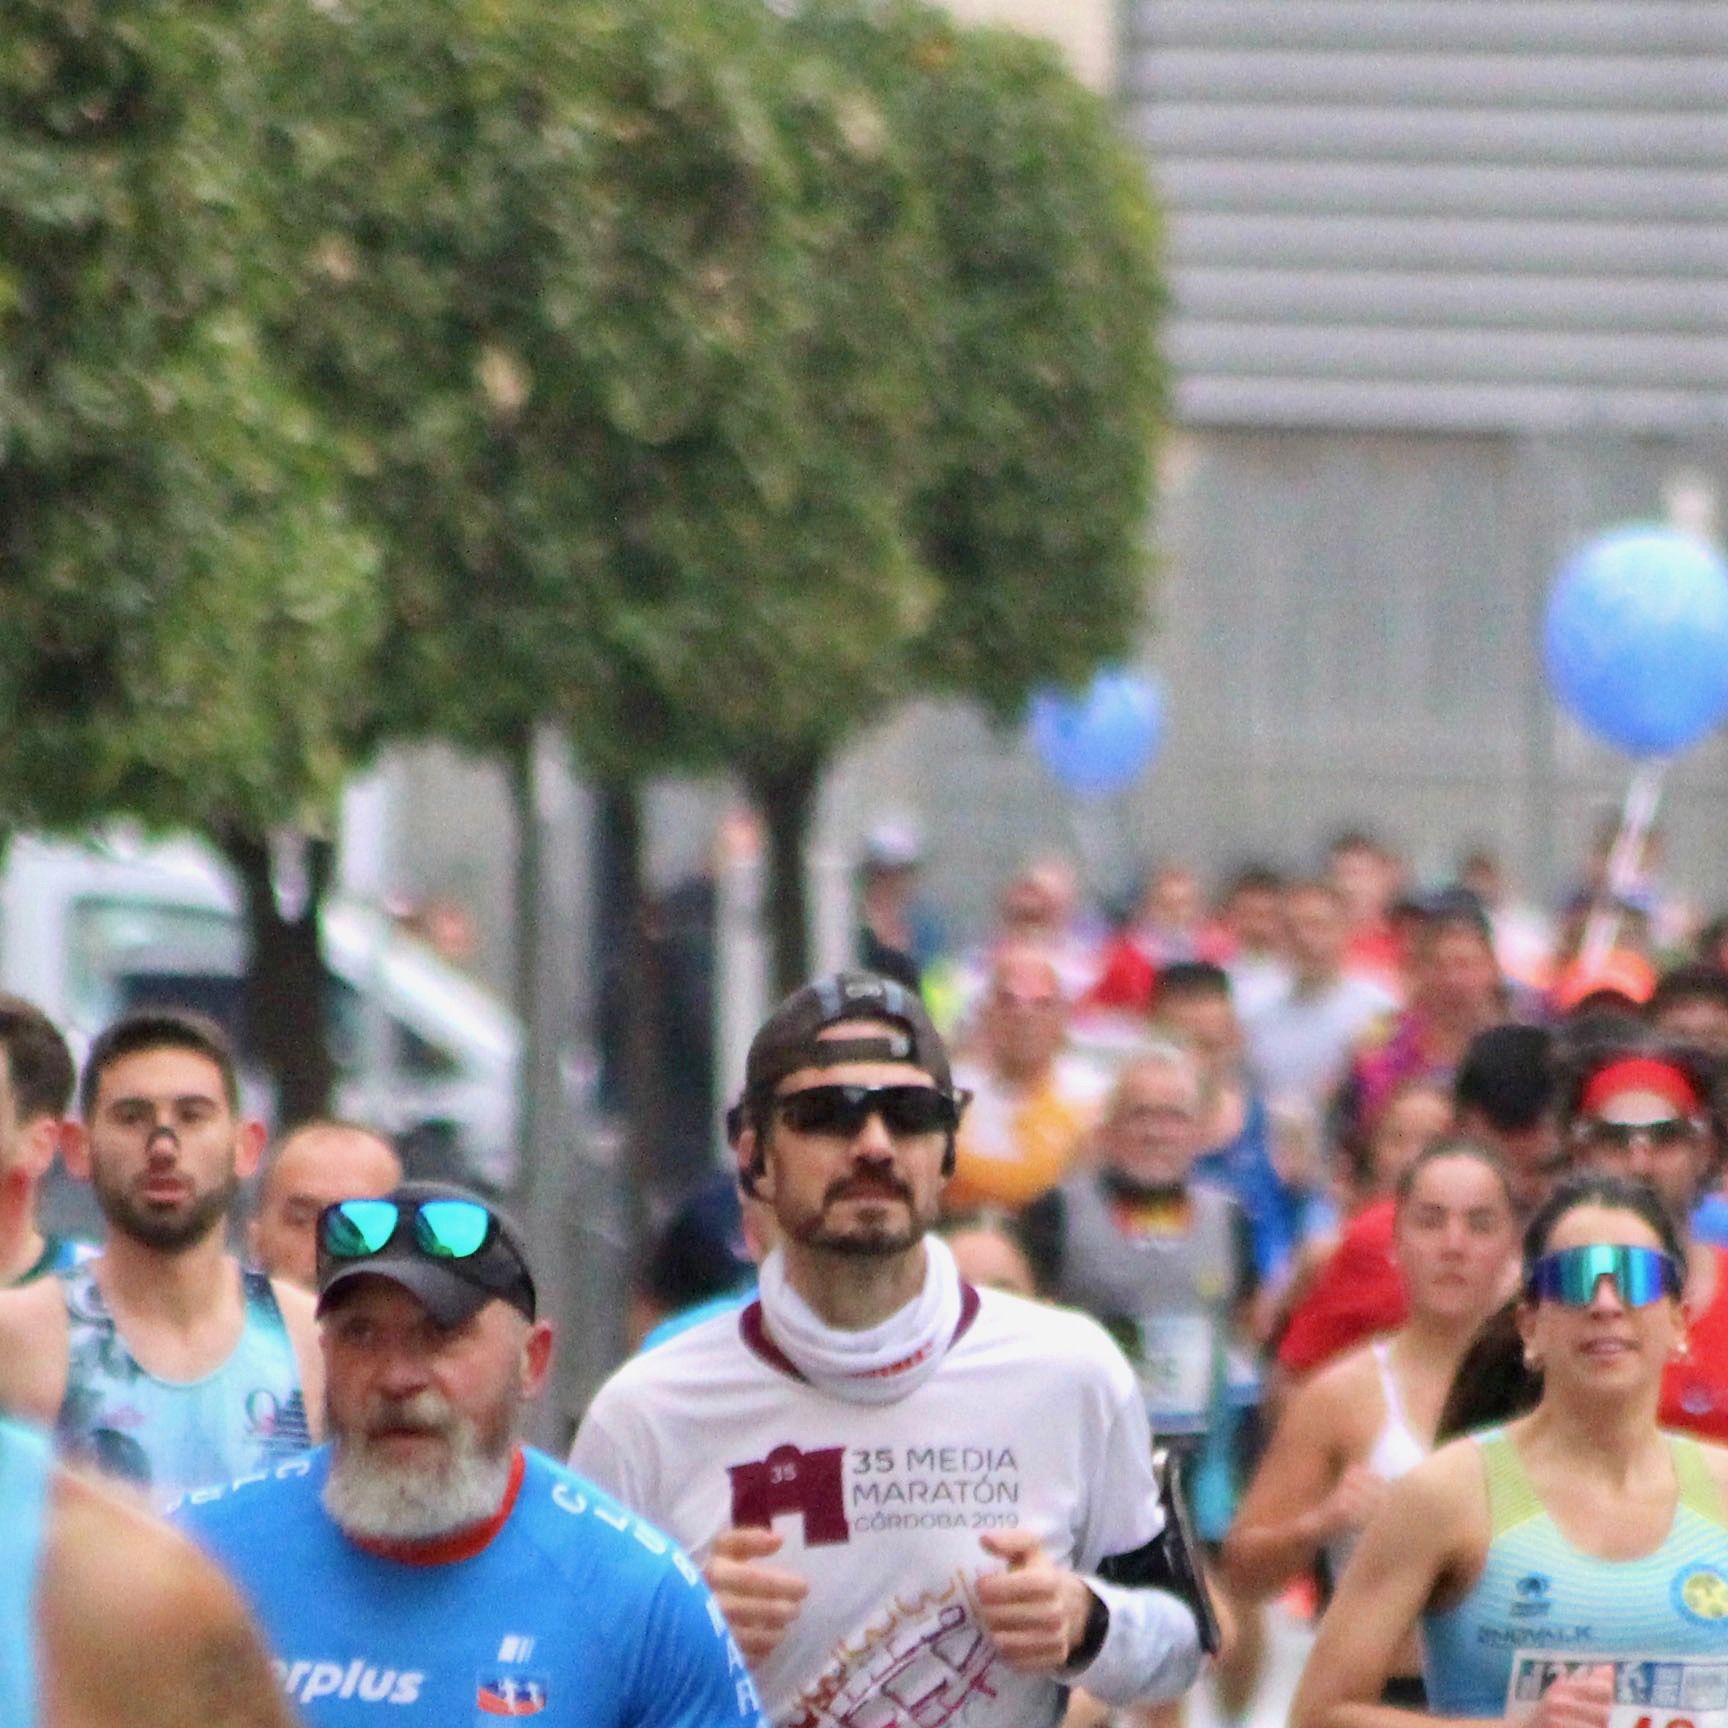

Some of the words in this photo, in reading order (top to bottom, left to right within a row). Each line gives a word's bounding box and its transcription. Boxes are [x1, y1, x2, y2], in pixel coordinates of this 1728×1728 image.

[771, 1461, 797, 1485] 35
[852, 1450, 894, 1475] 35
[906, 1447, 1019, 1473] MEDIA
[852, 1474, 1019, 1506] MARATÓN
[853, 1511, 967, 1533] CÓRDOBA
[972, 1511, 1020, 1530] 2019
